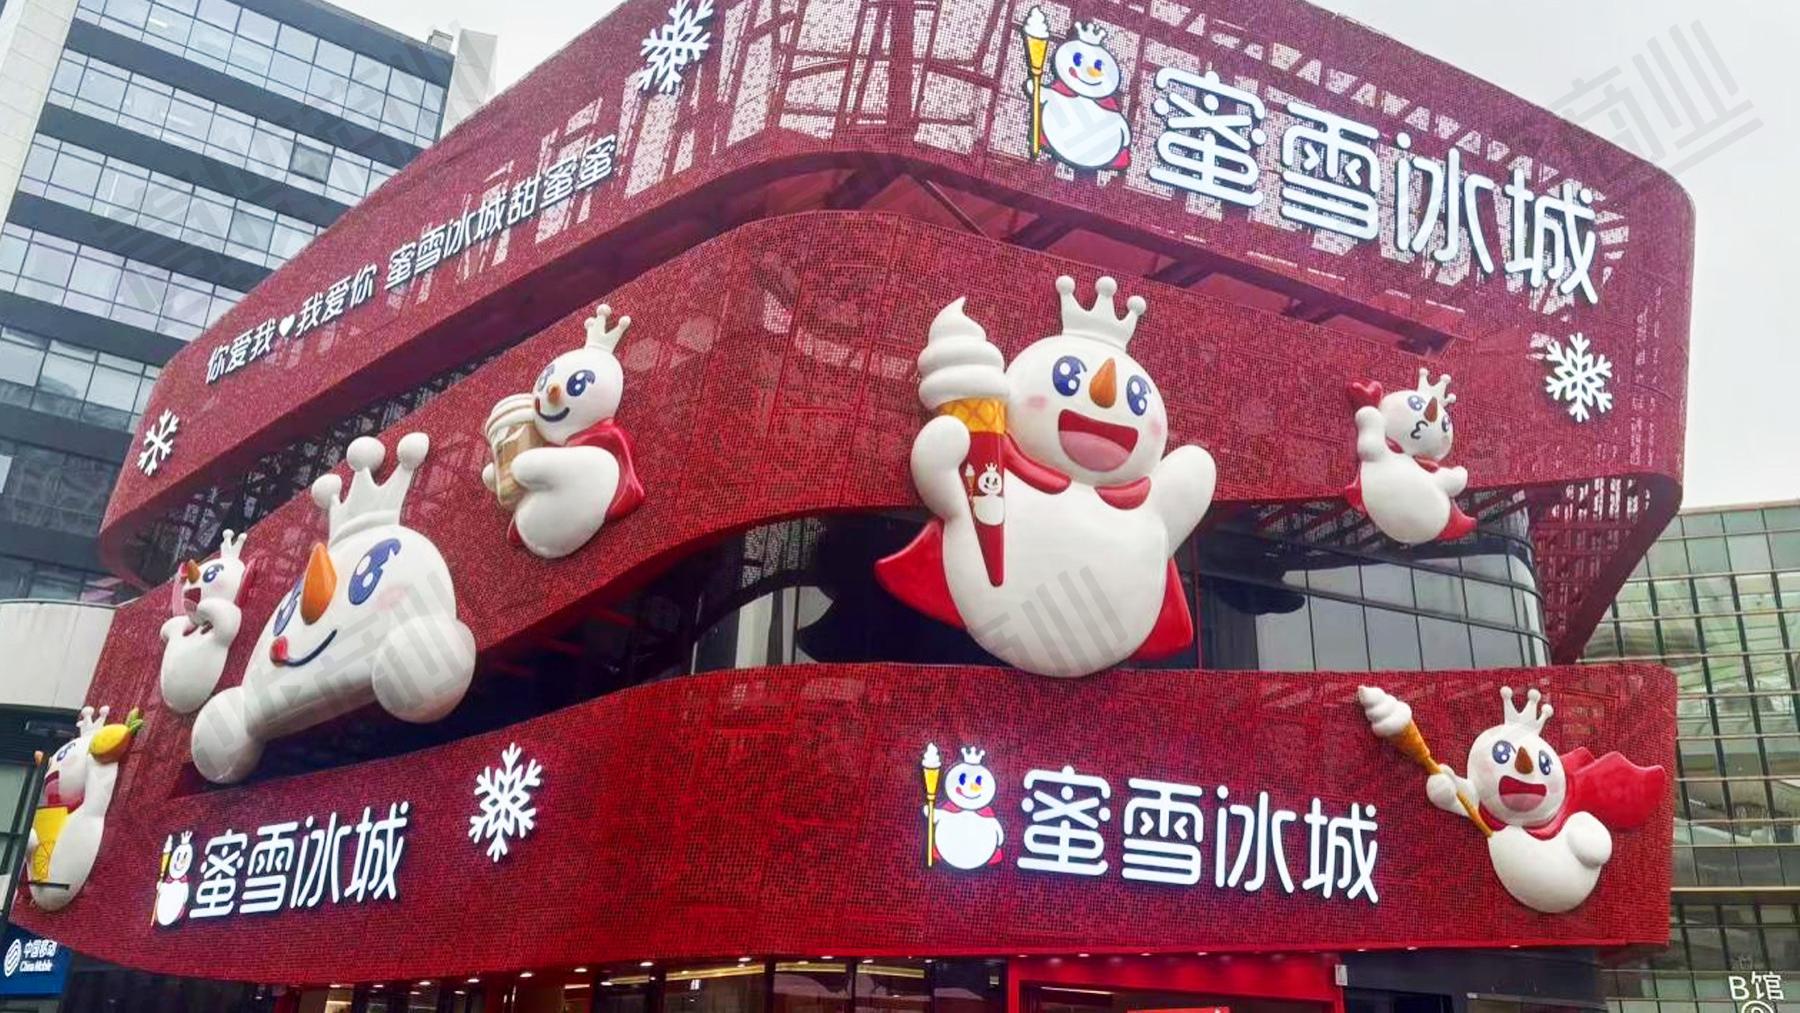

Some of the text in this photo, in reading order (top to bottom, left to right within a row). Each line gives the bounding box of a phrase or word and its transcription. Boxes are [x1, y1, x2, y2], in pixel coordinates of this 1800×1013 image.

[384, 133, 617, 291] 蜜雪冰城甜蜜蜜
[1150, 66, 1598, 304] 蜜雪冰城
[194, 801, 409, 918] 蜜雪冰城
[1018, 766, 1378, 902] 蜜雪冰城
